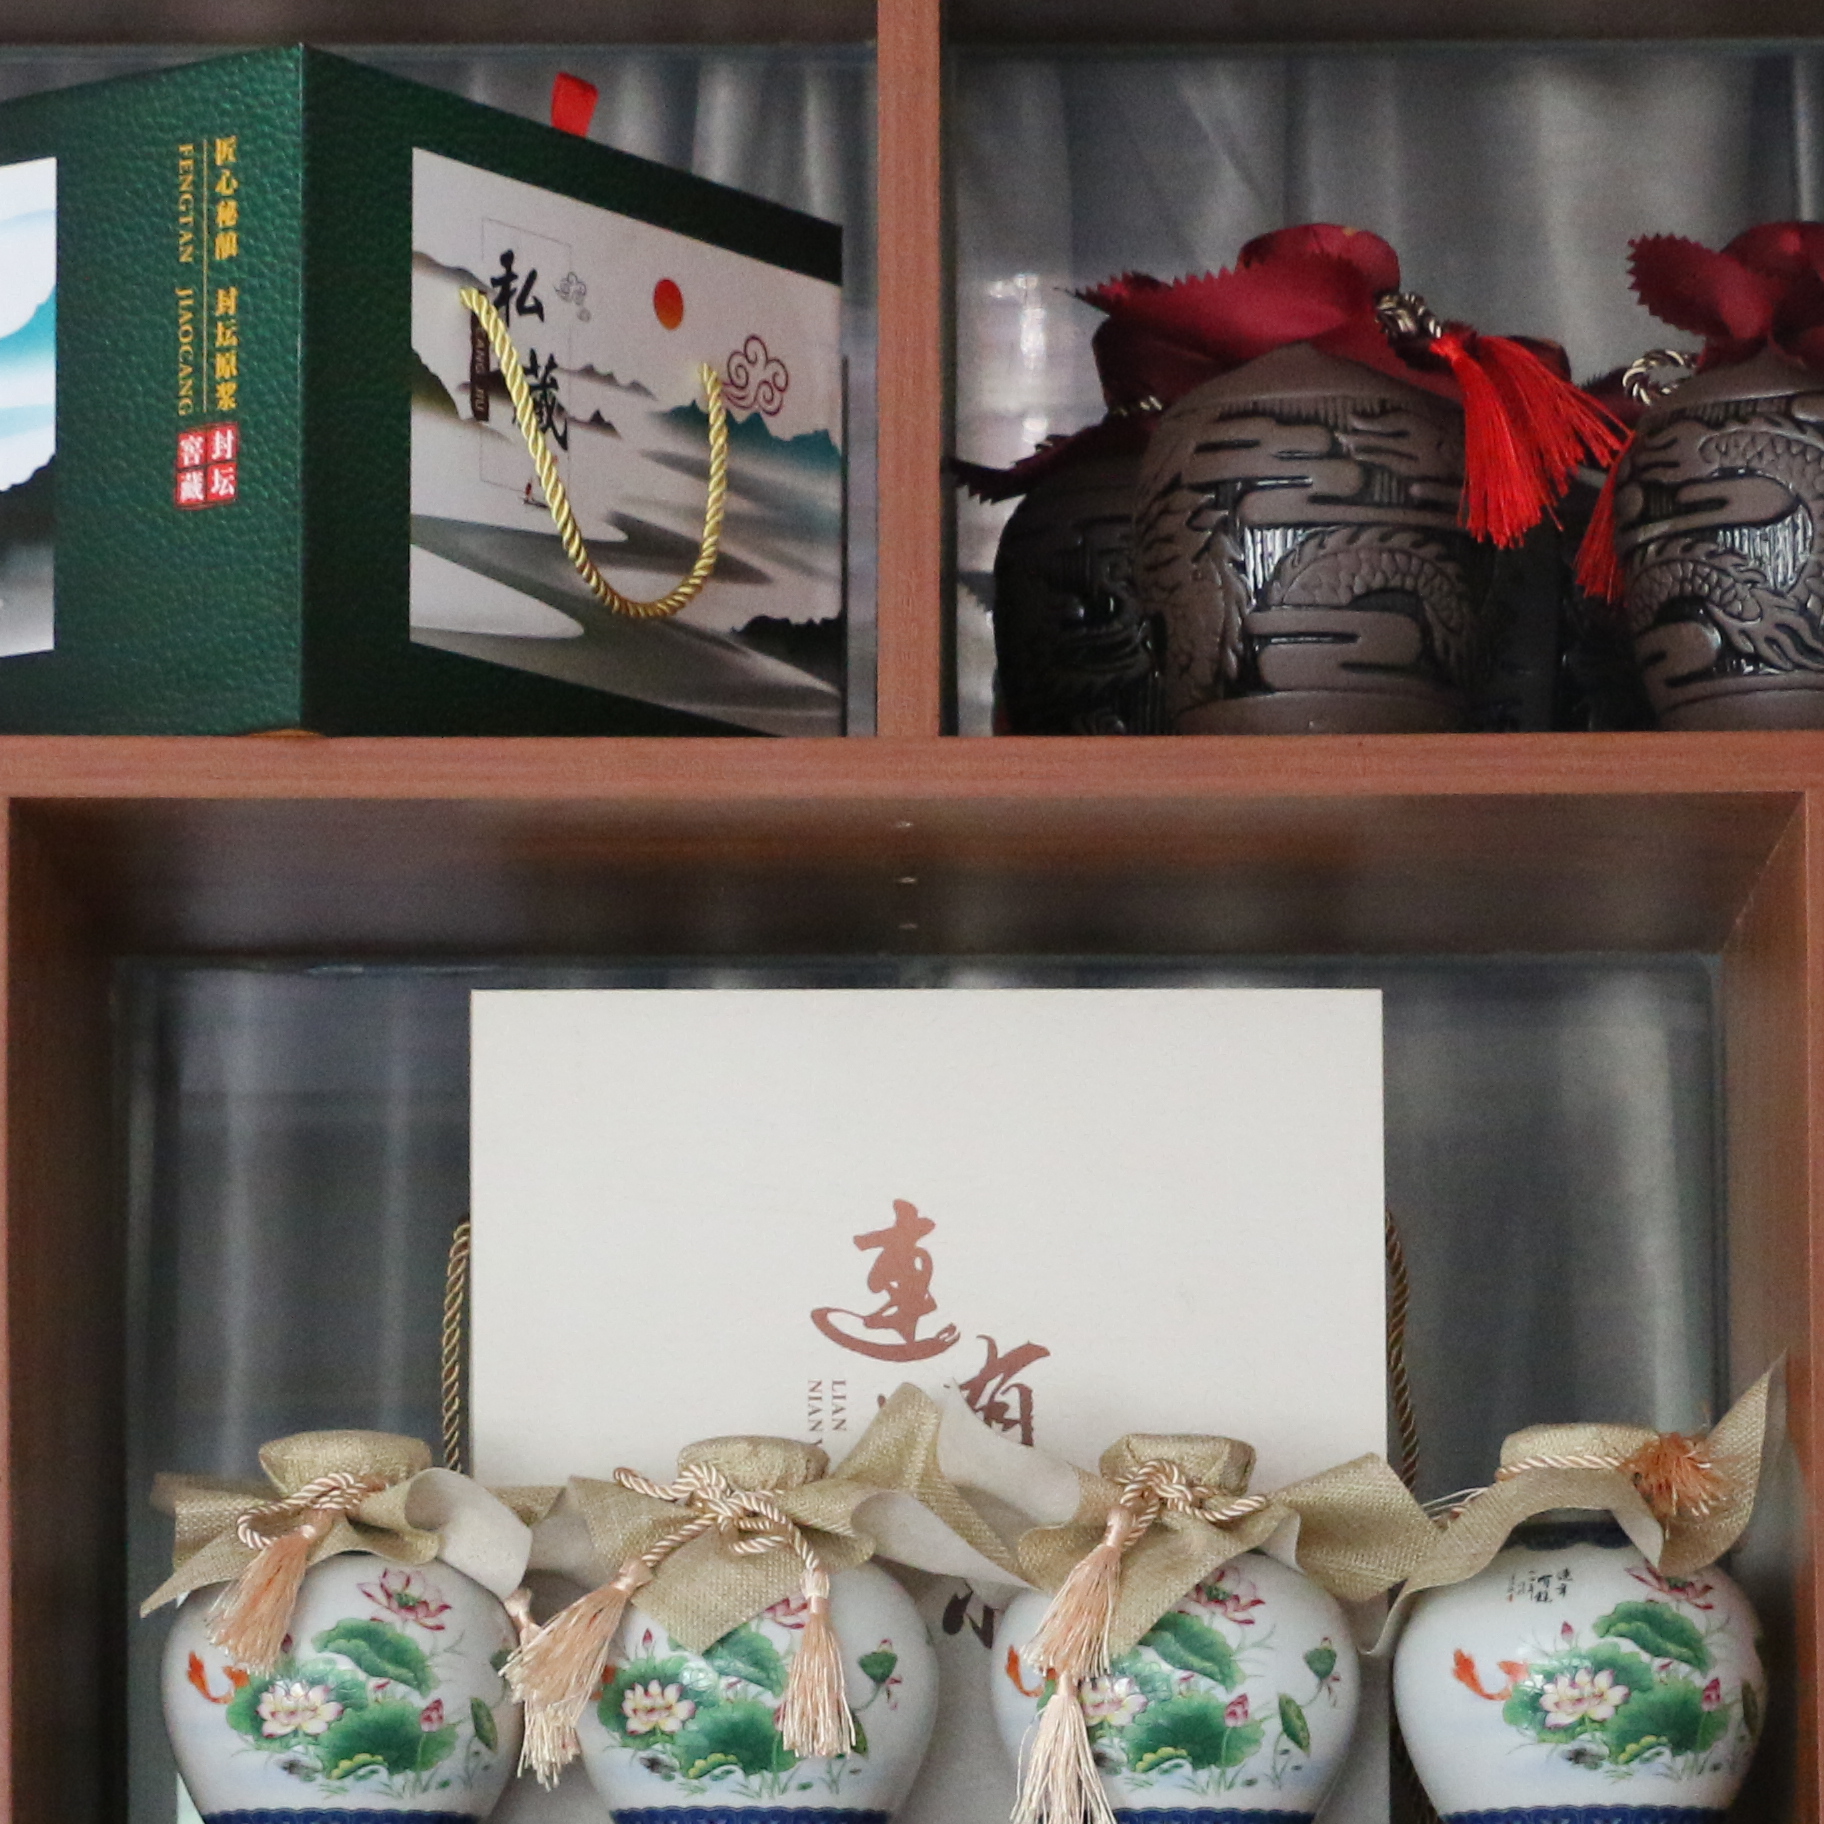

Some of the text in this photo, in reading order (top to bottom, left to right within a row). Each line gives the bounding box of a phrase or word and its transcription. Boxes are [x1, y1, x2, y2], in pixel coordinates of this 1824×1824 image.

[176, 142, 195, 416] FENGTAN JIAOCANG
[214, 286, 239, 412] 封坛原浆
[807, 1379, 824, 1432] NIAN
[831, 1379, 847, 1432] LIAN
